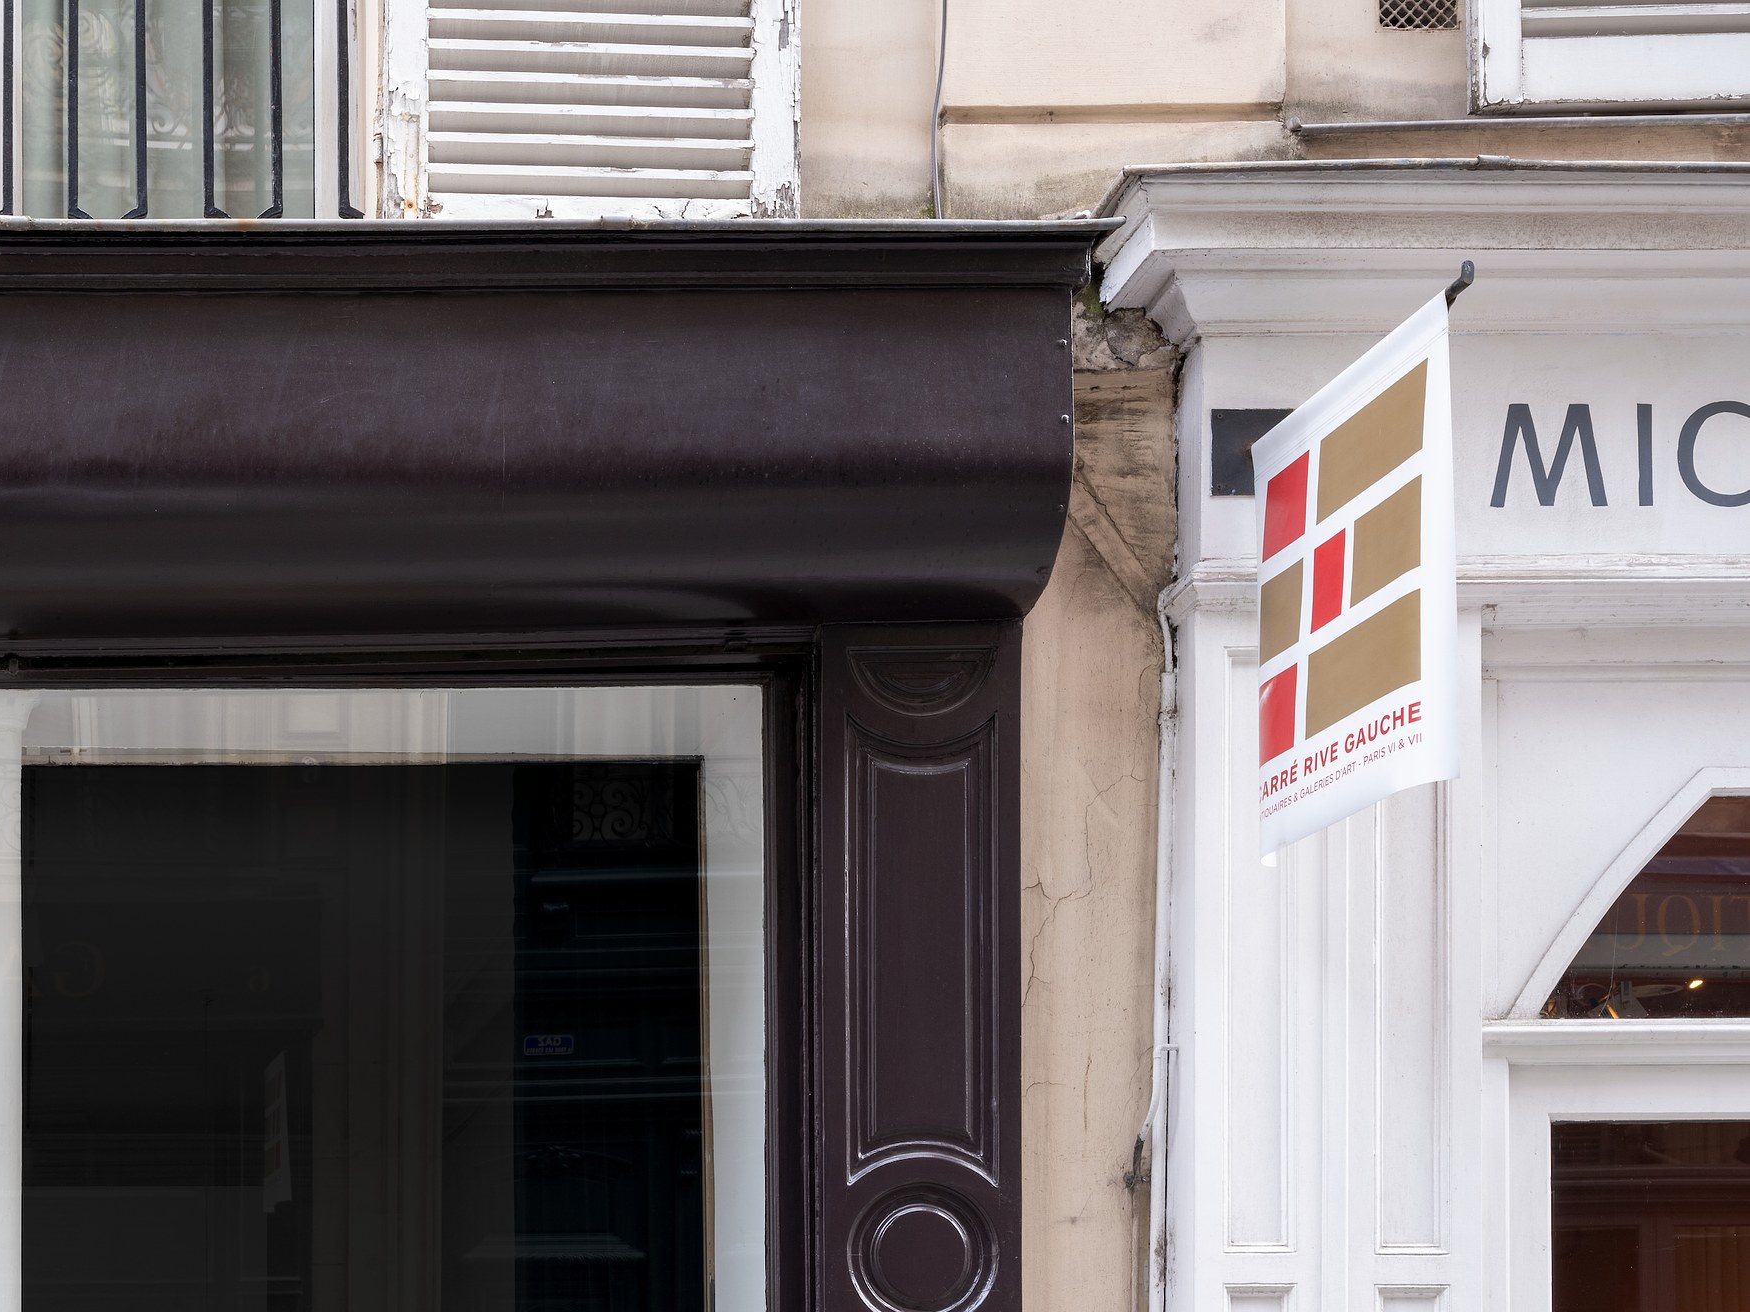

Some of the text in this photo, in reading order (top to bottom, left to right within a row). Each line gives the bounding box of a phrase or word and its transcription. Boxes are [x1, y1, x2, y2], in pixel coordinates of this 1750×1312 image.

[1490, 401, 1750, 507] MIC
[1259, 701, 1422, 804] ARRÉ RIVE GAUCHE
[1300, 774, 1334, 799] GALERIES
[1363, 747, 1386, 766] PARIS
[1388, 742, 1396, 754] VI
[1398, 738, 1405, 750] &
[1408, 732, 1423, 745] VII
